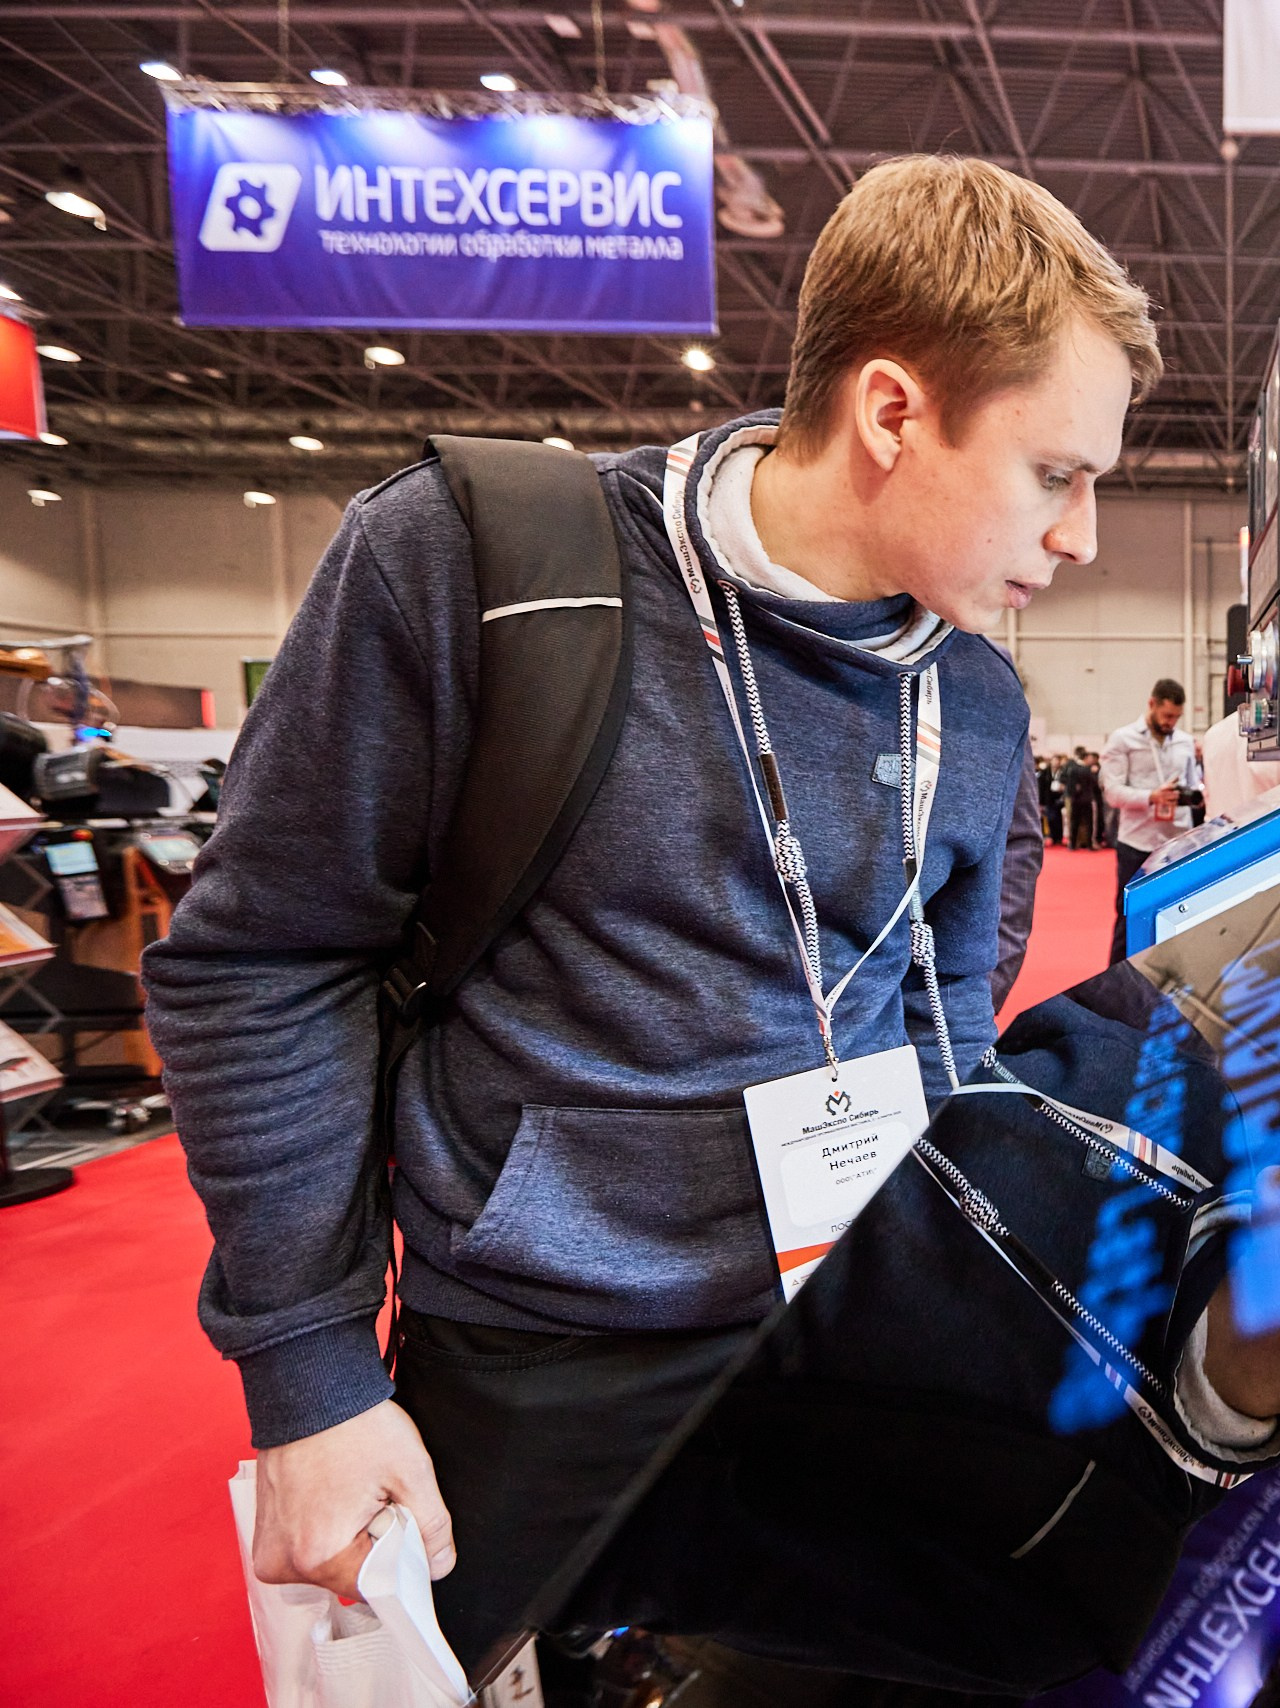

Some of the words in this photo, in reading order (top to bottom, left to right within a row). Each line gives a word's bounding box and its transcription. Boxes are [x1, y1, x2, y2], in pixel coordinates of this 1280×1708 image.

[315, 164, 683, 228] ИНТЕХСЕРВИС
[802, 1117, 848, 1135] МашЭкспо
[849, 1108, 880, 1122] Сибирь
[821, 1132, 880, 1159] Дмитрий
[829, 1150, 878, 1171] Нечаев
